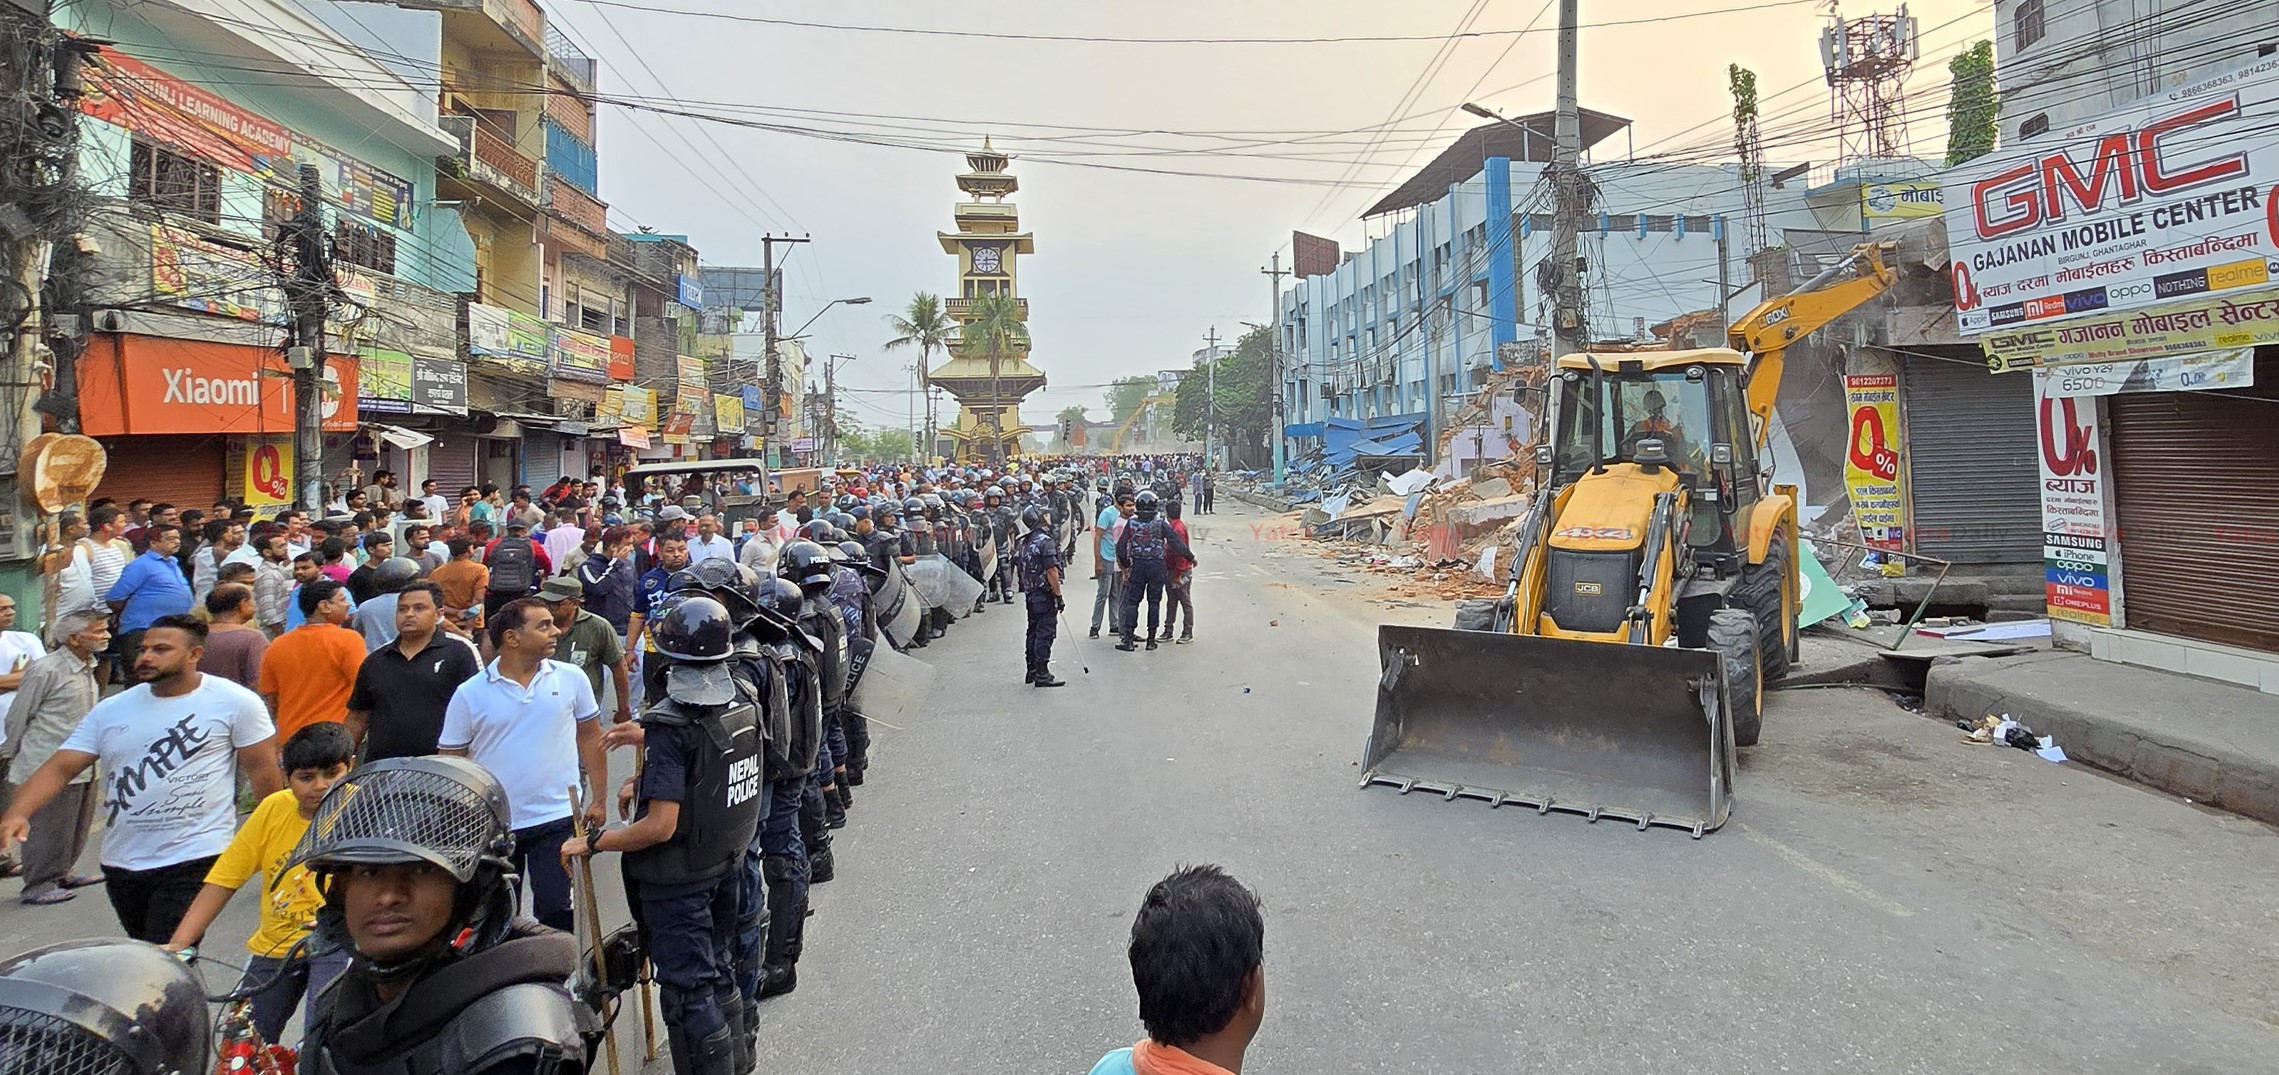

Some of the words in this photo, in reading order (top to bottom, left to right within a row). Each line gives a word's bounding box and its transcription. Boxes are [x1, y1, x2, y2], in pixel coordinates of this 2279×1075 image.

[179, 93, 238, 131] LEARNING
[240, 122, 291, 154] ACADEMY
[1971, 90, 2250, 241] GMC
[1973, 234, 2056, 272] GAJANAN
[2062, 212, 2146, 251] MOBILE
[2152, 186, 2261, 229] CENTER
[2092, 239, 2147, 258] GHANTAGHAR
[1992, 307, 2024, 320] SAMSUNG
[2066, 293, 2106, 309] vivo
[2158, 276, 2205, 294] NOTHING
[2210, 265, 2264, 284] realme
[2056, 321, 2126, 344] गजानन
[2130, 312, 2212, 335] मोबाइल
[2253, 331, 2279, 340] viv
[1990, 329, 2055, 349] GMC
[2064, 366, 2091, 376] vivo
[2093, 364, 2113, 373] Y29
[162, 368, 259, 405] Xiaomi
[2063, 377, 2106, 391] 6500
[2046, 534, 2102, 549] SAMSUNG
[2064, 549, 2094, 561] iPhone
[2057, 572, 2095, 587] vivo
[2066, 599, 2101, 610] ONEPLUS
[2056, 608, 2100, 623] realme
[845, 654, 866, 690] OLICE
[729, 754, 759, 785] NEPAL
[727, 775, 759, 808] POLICE
